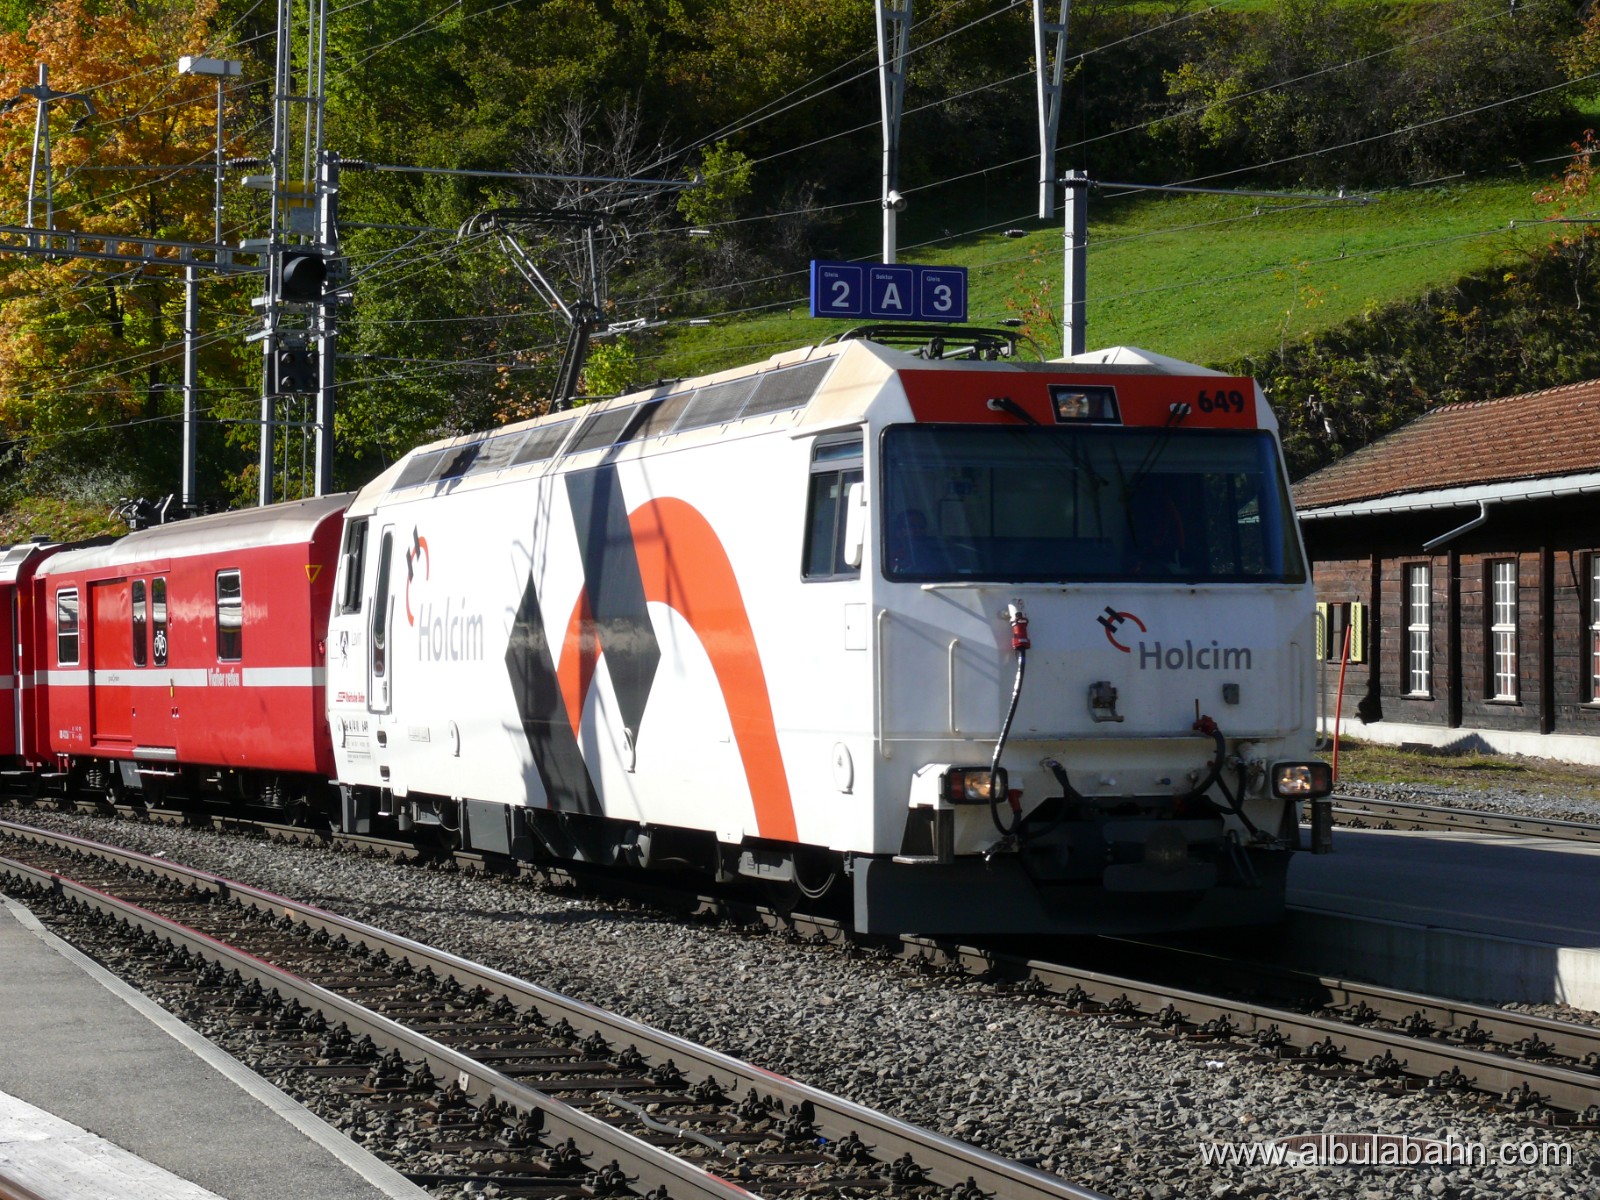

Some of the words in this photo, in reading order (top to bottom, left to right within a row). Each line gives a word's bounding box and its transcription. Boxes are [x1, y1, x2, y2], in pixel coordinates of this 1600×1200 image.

[831, 280, 850, 308] 2
[881, 282, 903, 310] A
[933, 284, 952, 312] 3
[1197, 389, 1245, 414] 649
[418, 596, 484, 662] Holcim
[1138, 639, 1252, 670] Holcim
